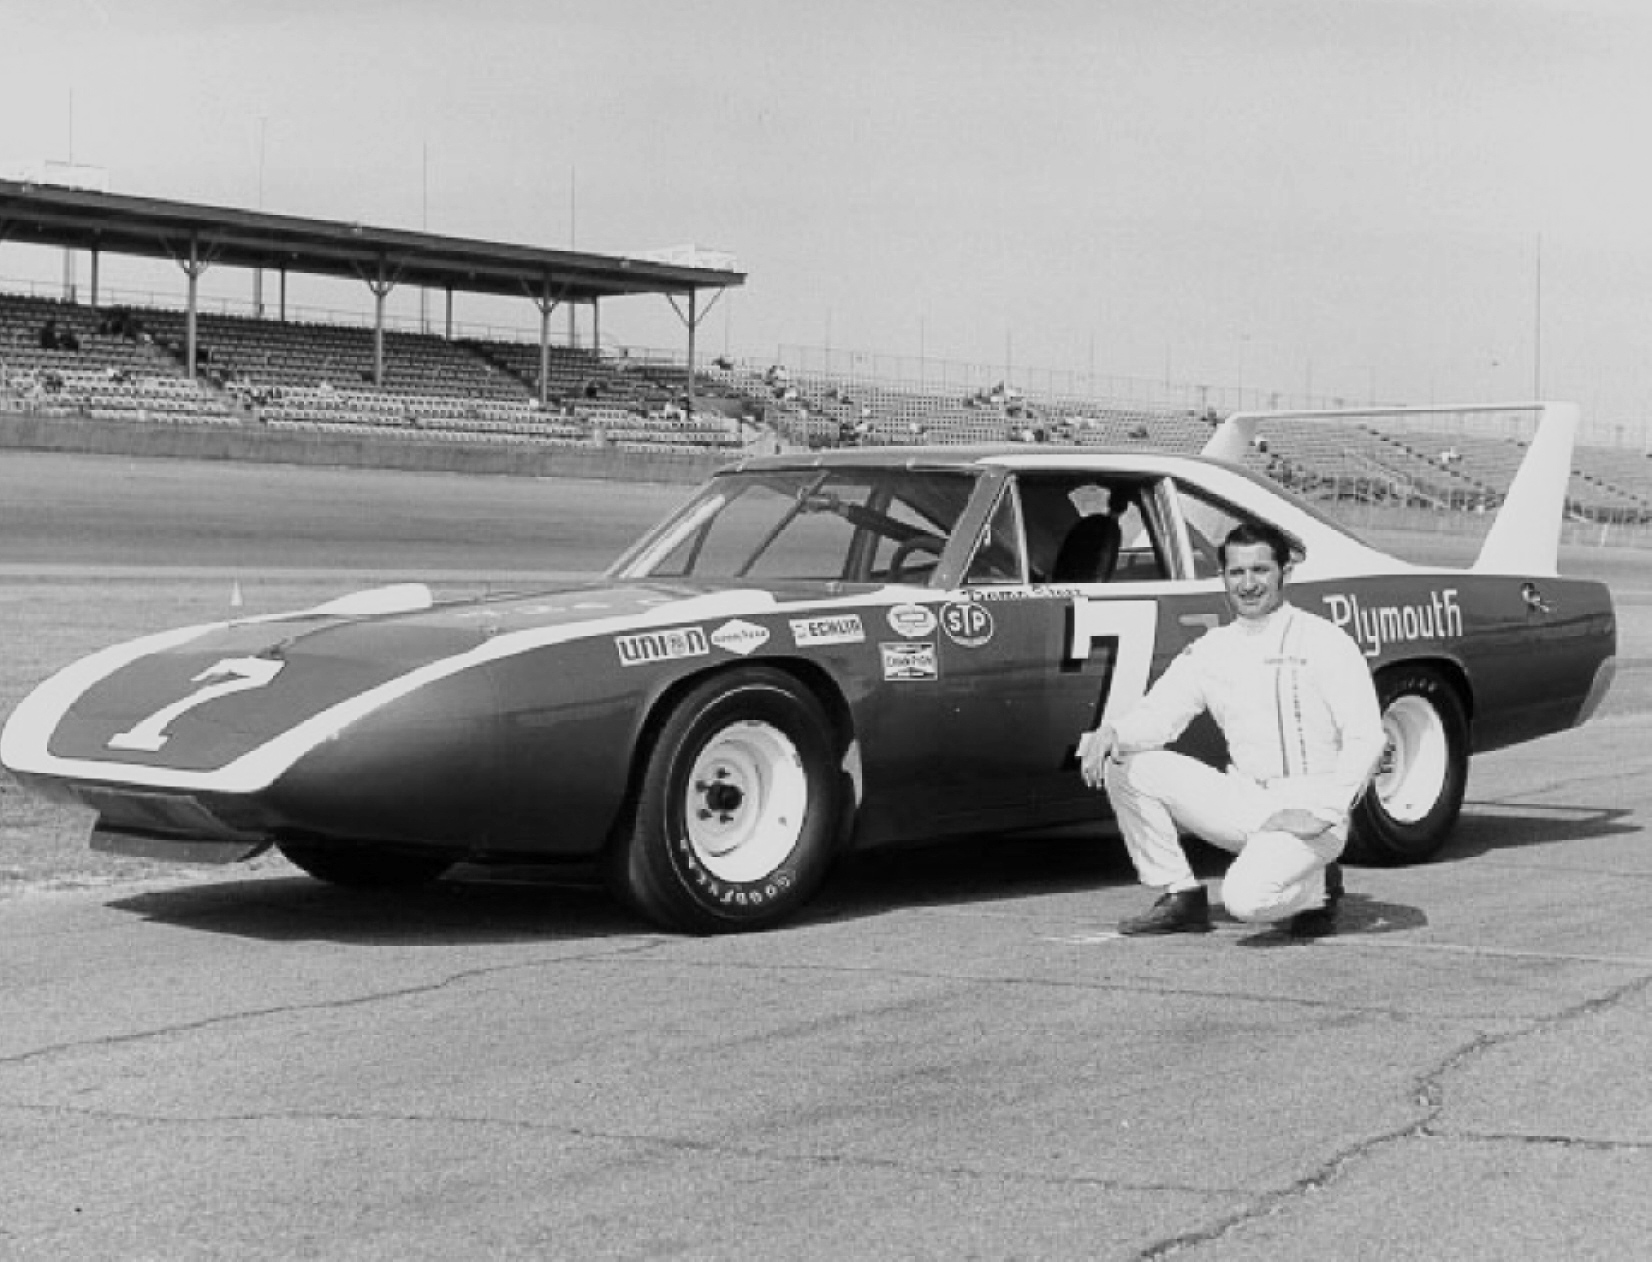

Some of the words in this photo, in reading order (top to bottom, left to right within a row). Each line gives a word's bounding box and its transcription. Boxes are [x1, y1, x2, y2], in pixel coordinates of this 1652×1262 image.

[947, 604, 986, 636] STP
[1322, 589, 1463, 656] Plymouth
[107, 656, 285, 752] 7
[1071, 597, 1157, 757] 7
